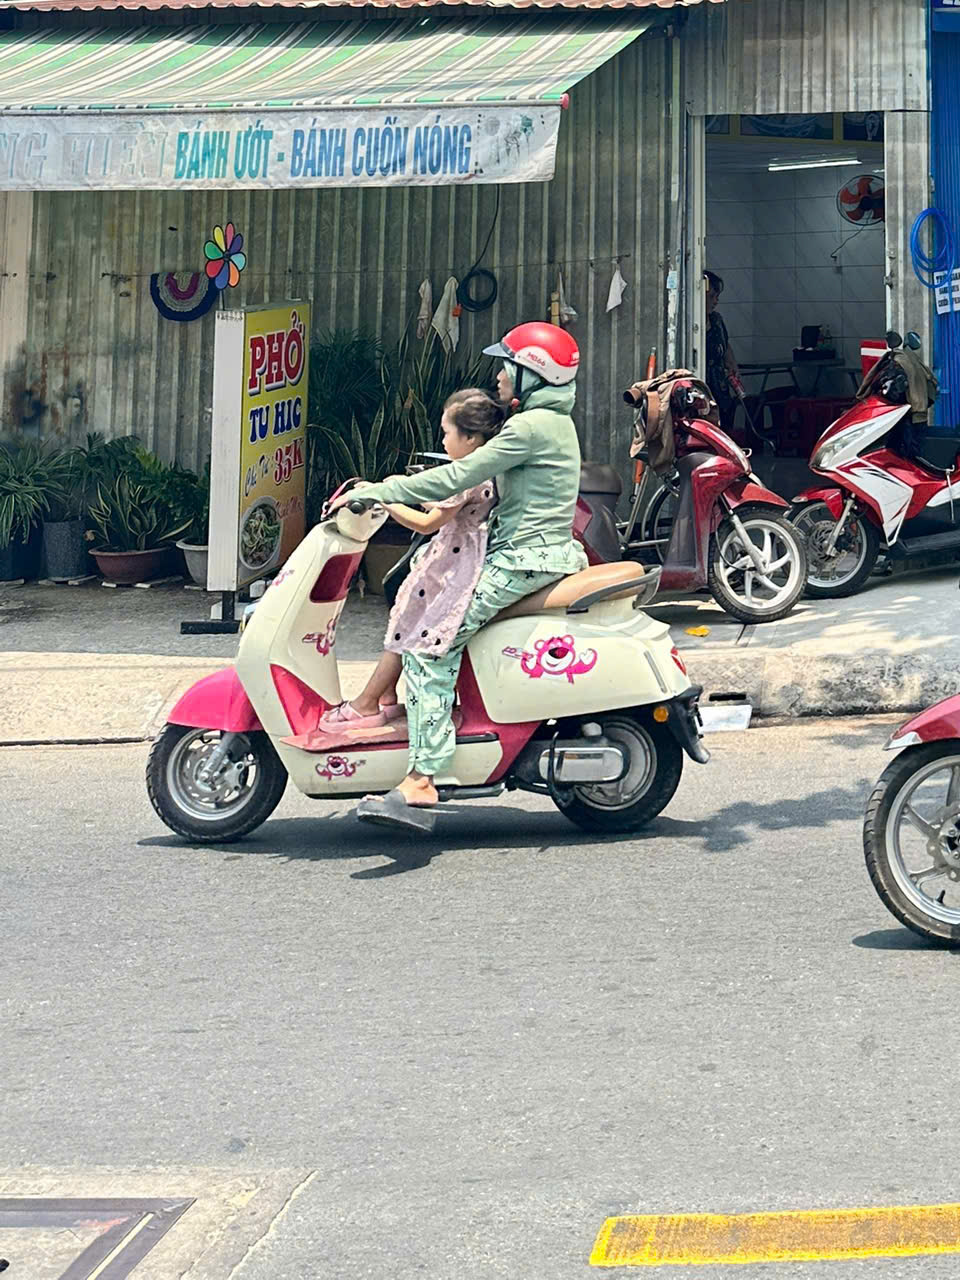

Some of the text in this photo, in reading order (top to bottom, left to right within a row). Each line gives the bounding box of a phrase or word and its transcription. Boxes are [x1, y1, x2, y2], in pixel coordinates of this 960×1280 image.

[174, 120, 231, 180] BÁNH
[289, 118, 347, 178] BÁNH
[351, 116, 410, 177] CUỐN
[412, 114, 472, 176] NÓNG
[248, 309, 305, 397] PHỞ
[249, 396, 302, 444] TU HIC
